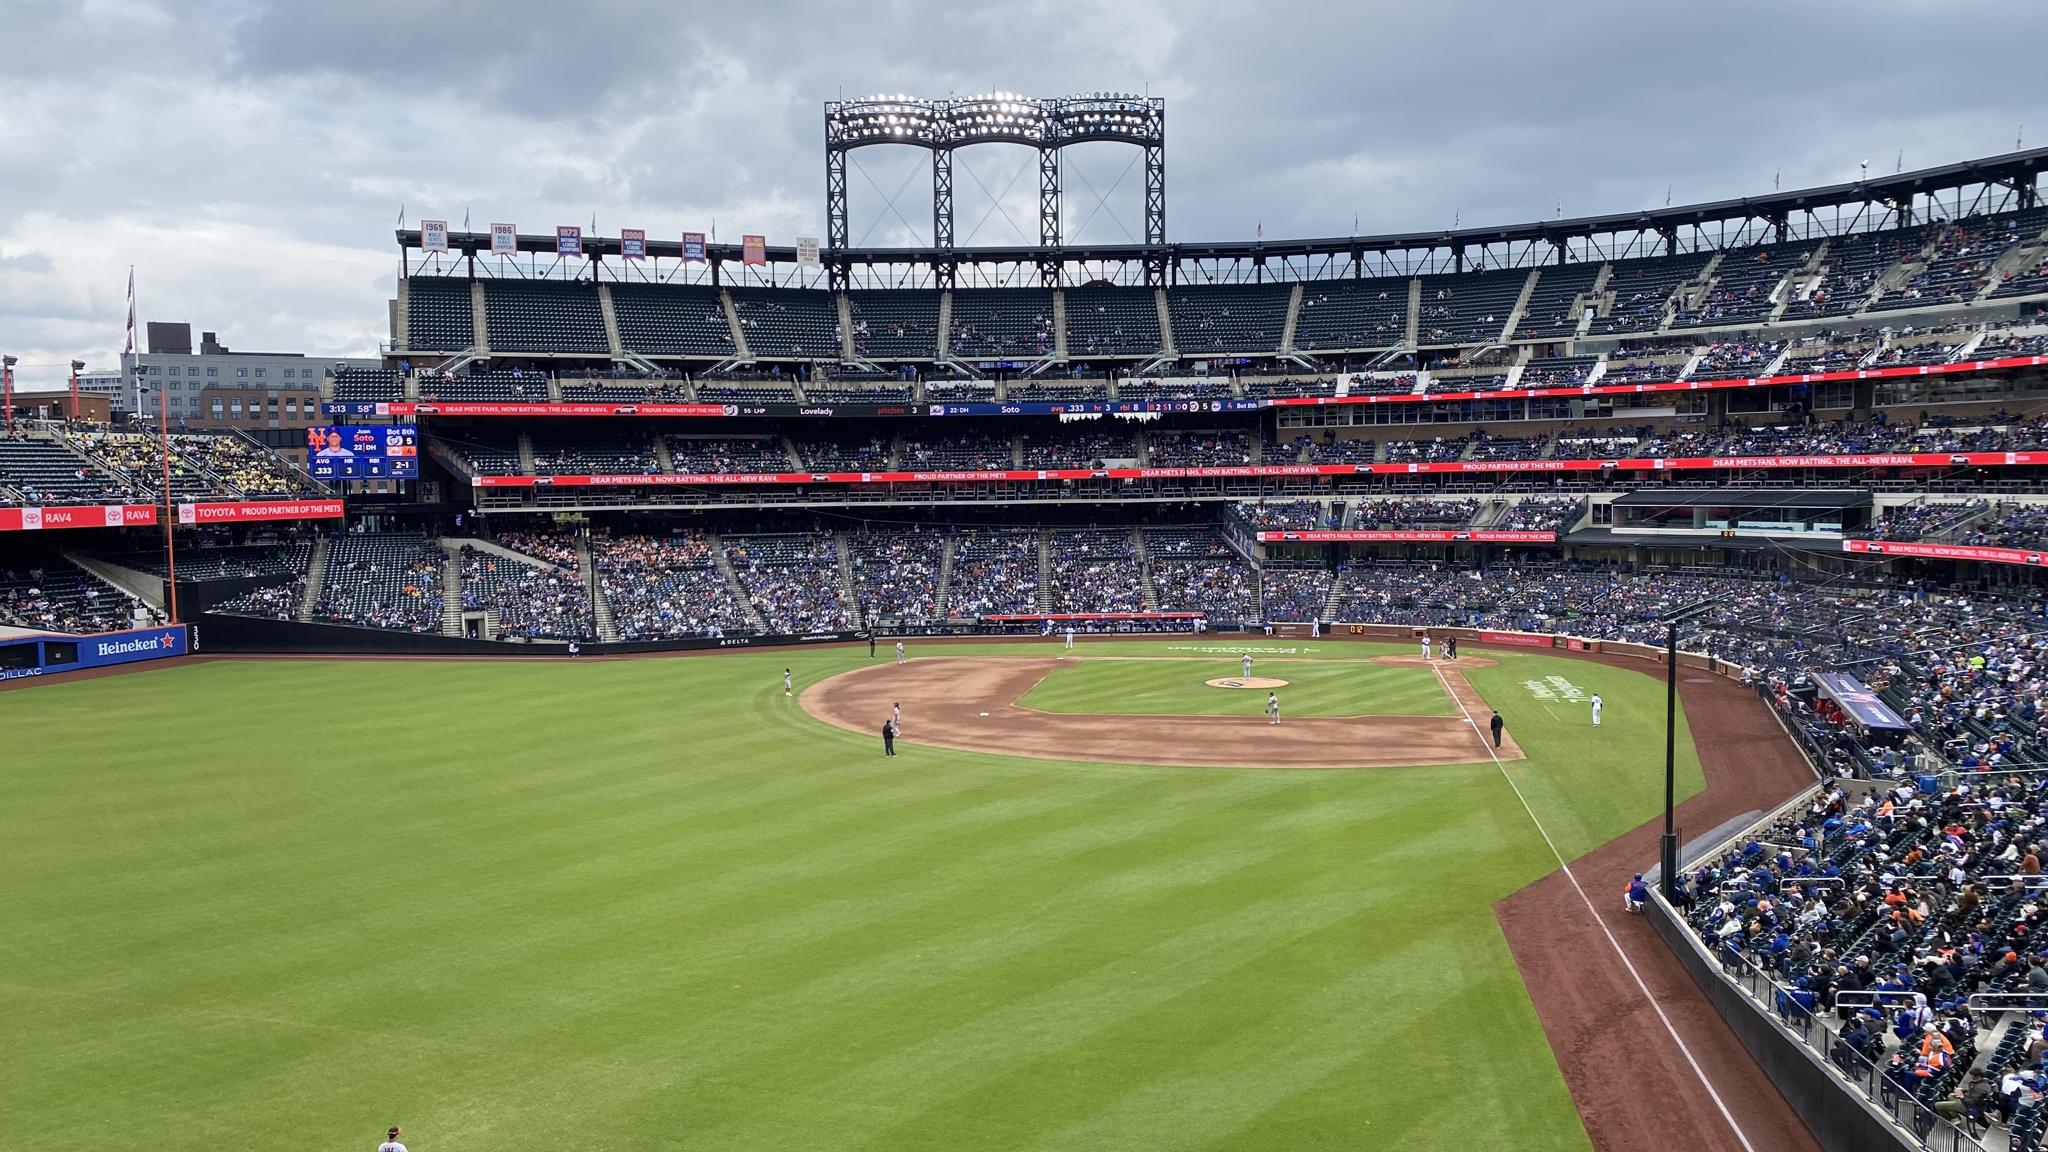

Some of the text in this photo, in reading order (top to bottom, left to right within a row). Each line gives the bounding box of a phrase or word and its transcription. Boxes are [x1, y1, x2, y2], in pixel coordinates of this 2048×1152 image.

[495, 226, 512, 234] 1986
[329, 404, 373, 413] 3:13 58°
[800, 407, 833, 416] Lovelady
[878, 405, 905, 416] pitches
[1001, 405, 1020, 413] Soto
[1050, 406, 1065, 414] avg
[1068, 404, 1084, 412] .333
[353, 434, 374, 442] Soto
[1890, 456, 1915, 464] RAV4.
[395, 461, 409, 469] 2-1
[126, 510, 150, 520] RAV4
[198, 504, 341, 517] TOYOTA PROUD PARTNER OF THE METS
[45, 513, 72, 523] RAV4
[98, 638, 158, 656] Heineken
